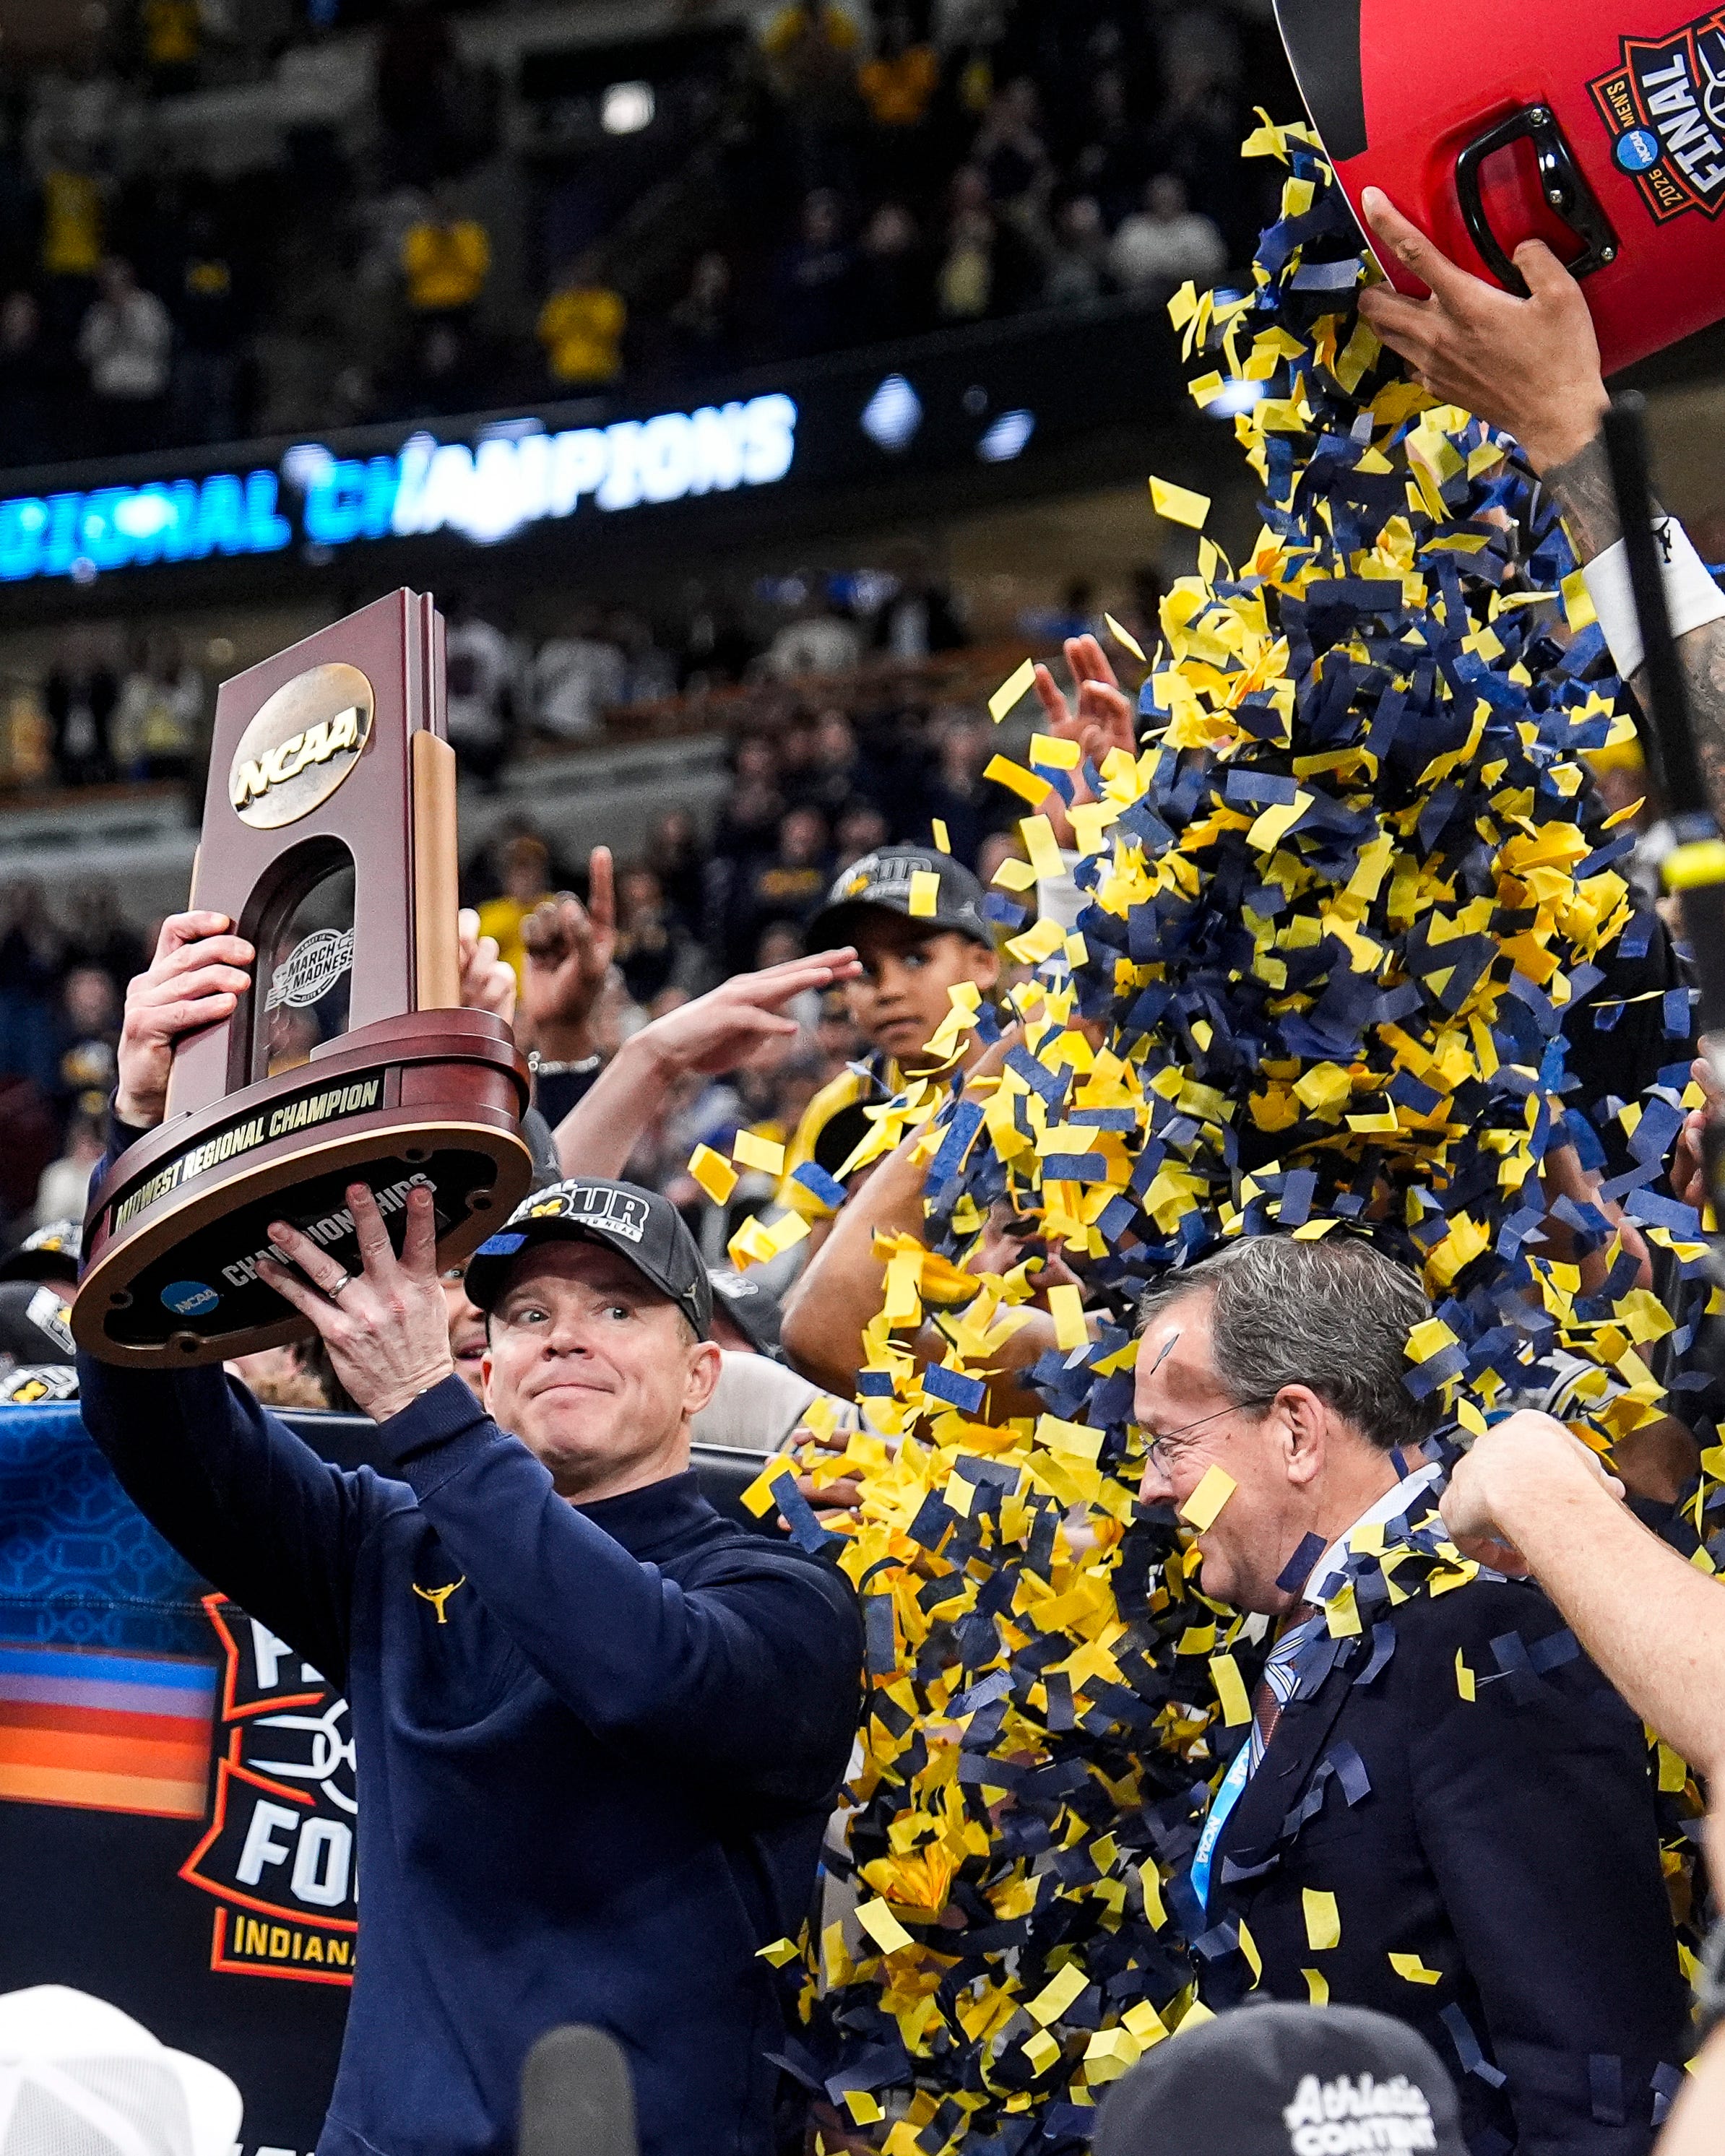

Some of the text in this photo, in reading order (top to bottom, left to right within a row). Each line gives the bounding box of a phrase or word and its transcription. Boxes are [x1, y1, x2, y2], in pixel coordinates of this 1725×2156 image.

[1607, 80, 1683, 206] 2026 NCAA MEN'S
[1642, 54, 1725, 193] FINAL
[305, 394, 797, 543] CHAMPIONS
[235, 706, 359, 808] NCAA
[288, 940, 335, 977] MARCH
[116, 1080, 379, 1234] MIDWEST REGIONAL CHAMPION
[174, 1289, 218, 1313] NCAA
[1227, 1746, 1250, 1785] CAA
[235, 1799, 359, 1907] FO
[1196, 1815, 1222, 1863] NCAA
[234, 1915, 356, 1966] INDIAN
[1281, 2070, 1431, 2131] Athletic
